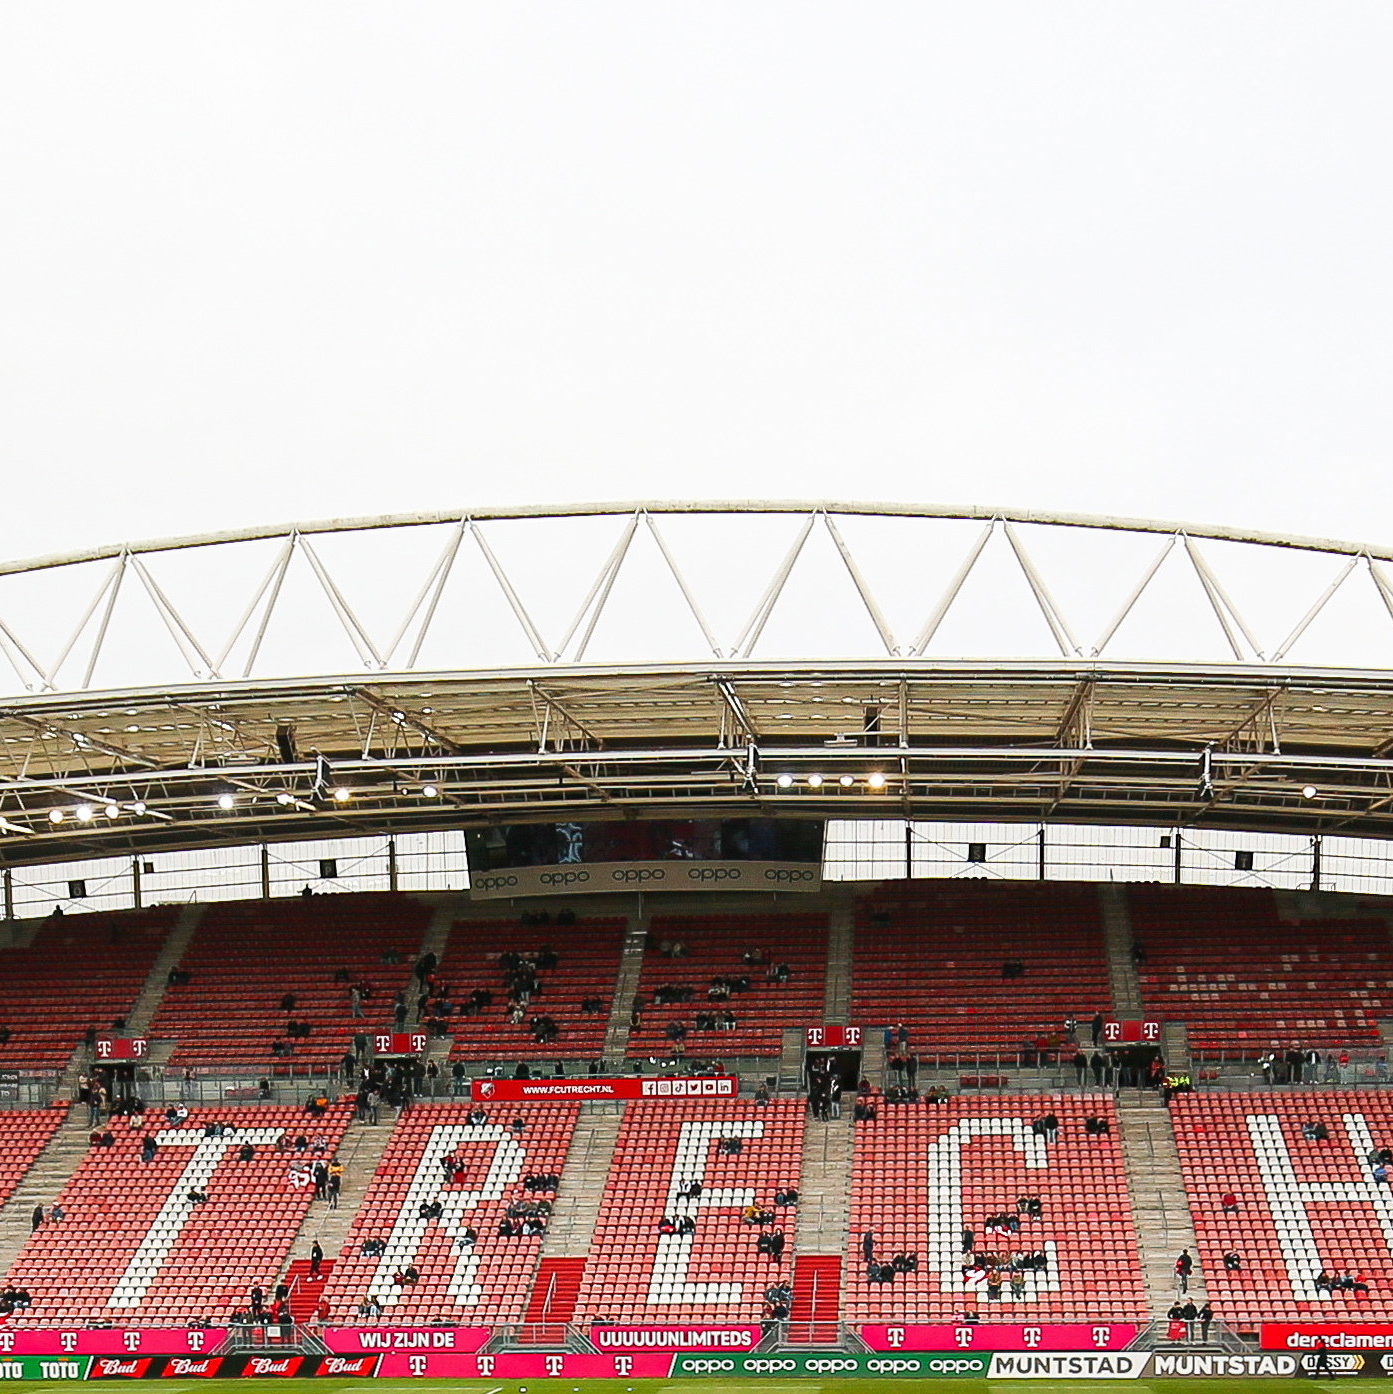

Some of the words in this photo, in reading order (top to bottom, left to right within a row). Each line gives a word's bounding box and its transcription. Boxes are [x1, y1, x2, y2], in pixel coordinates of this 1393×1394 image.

[475, 873, 518, 892] oppo
[540, 871, 590, 886] oppo
[612, 868, 665, 884] oppo
[688, 867, 741, 883] oppo
[764, 868, 814, 883] oppo
[359, 1333, 390, 1348] WIJ
[394, 1333, 429, 1348] ZIJN
[433, 1333, 454, 1348] DE
[40, 1361, 79, 1378] TOTO
[100, 1358, 138, 1375] Bud
[171, 1358, 208, 1375] Bud
[251, 1358, 288, 1374] Bud
[325, 1357, 363, 1373] Bud
[682, 1360, 734, 1374] oppo
[744, 1360, 796, 1374] oppo
[806, 1359, 858, 1373] oppo
[867, 1359, 920, 1373] oppo
[930, 1359, 983, 1373] oppo
[996, 1357, 1133, 1375] MUNTSTAD
[1155, 1355, 1296, 1376] MUNTSTAD
[1308, 1356, 1350, 1368] DSSY
